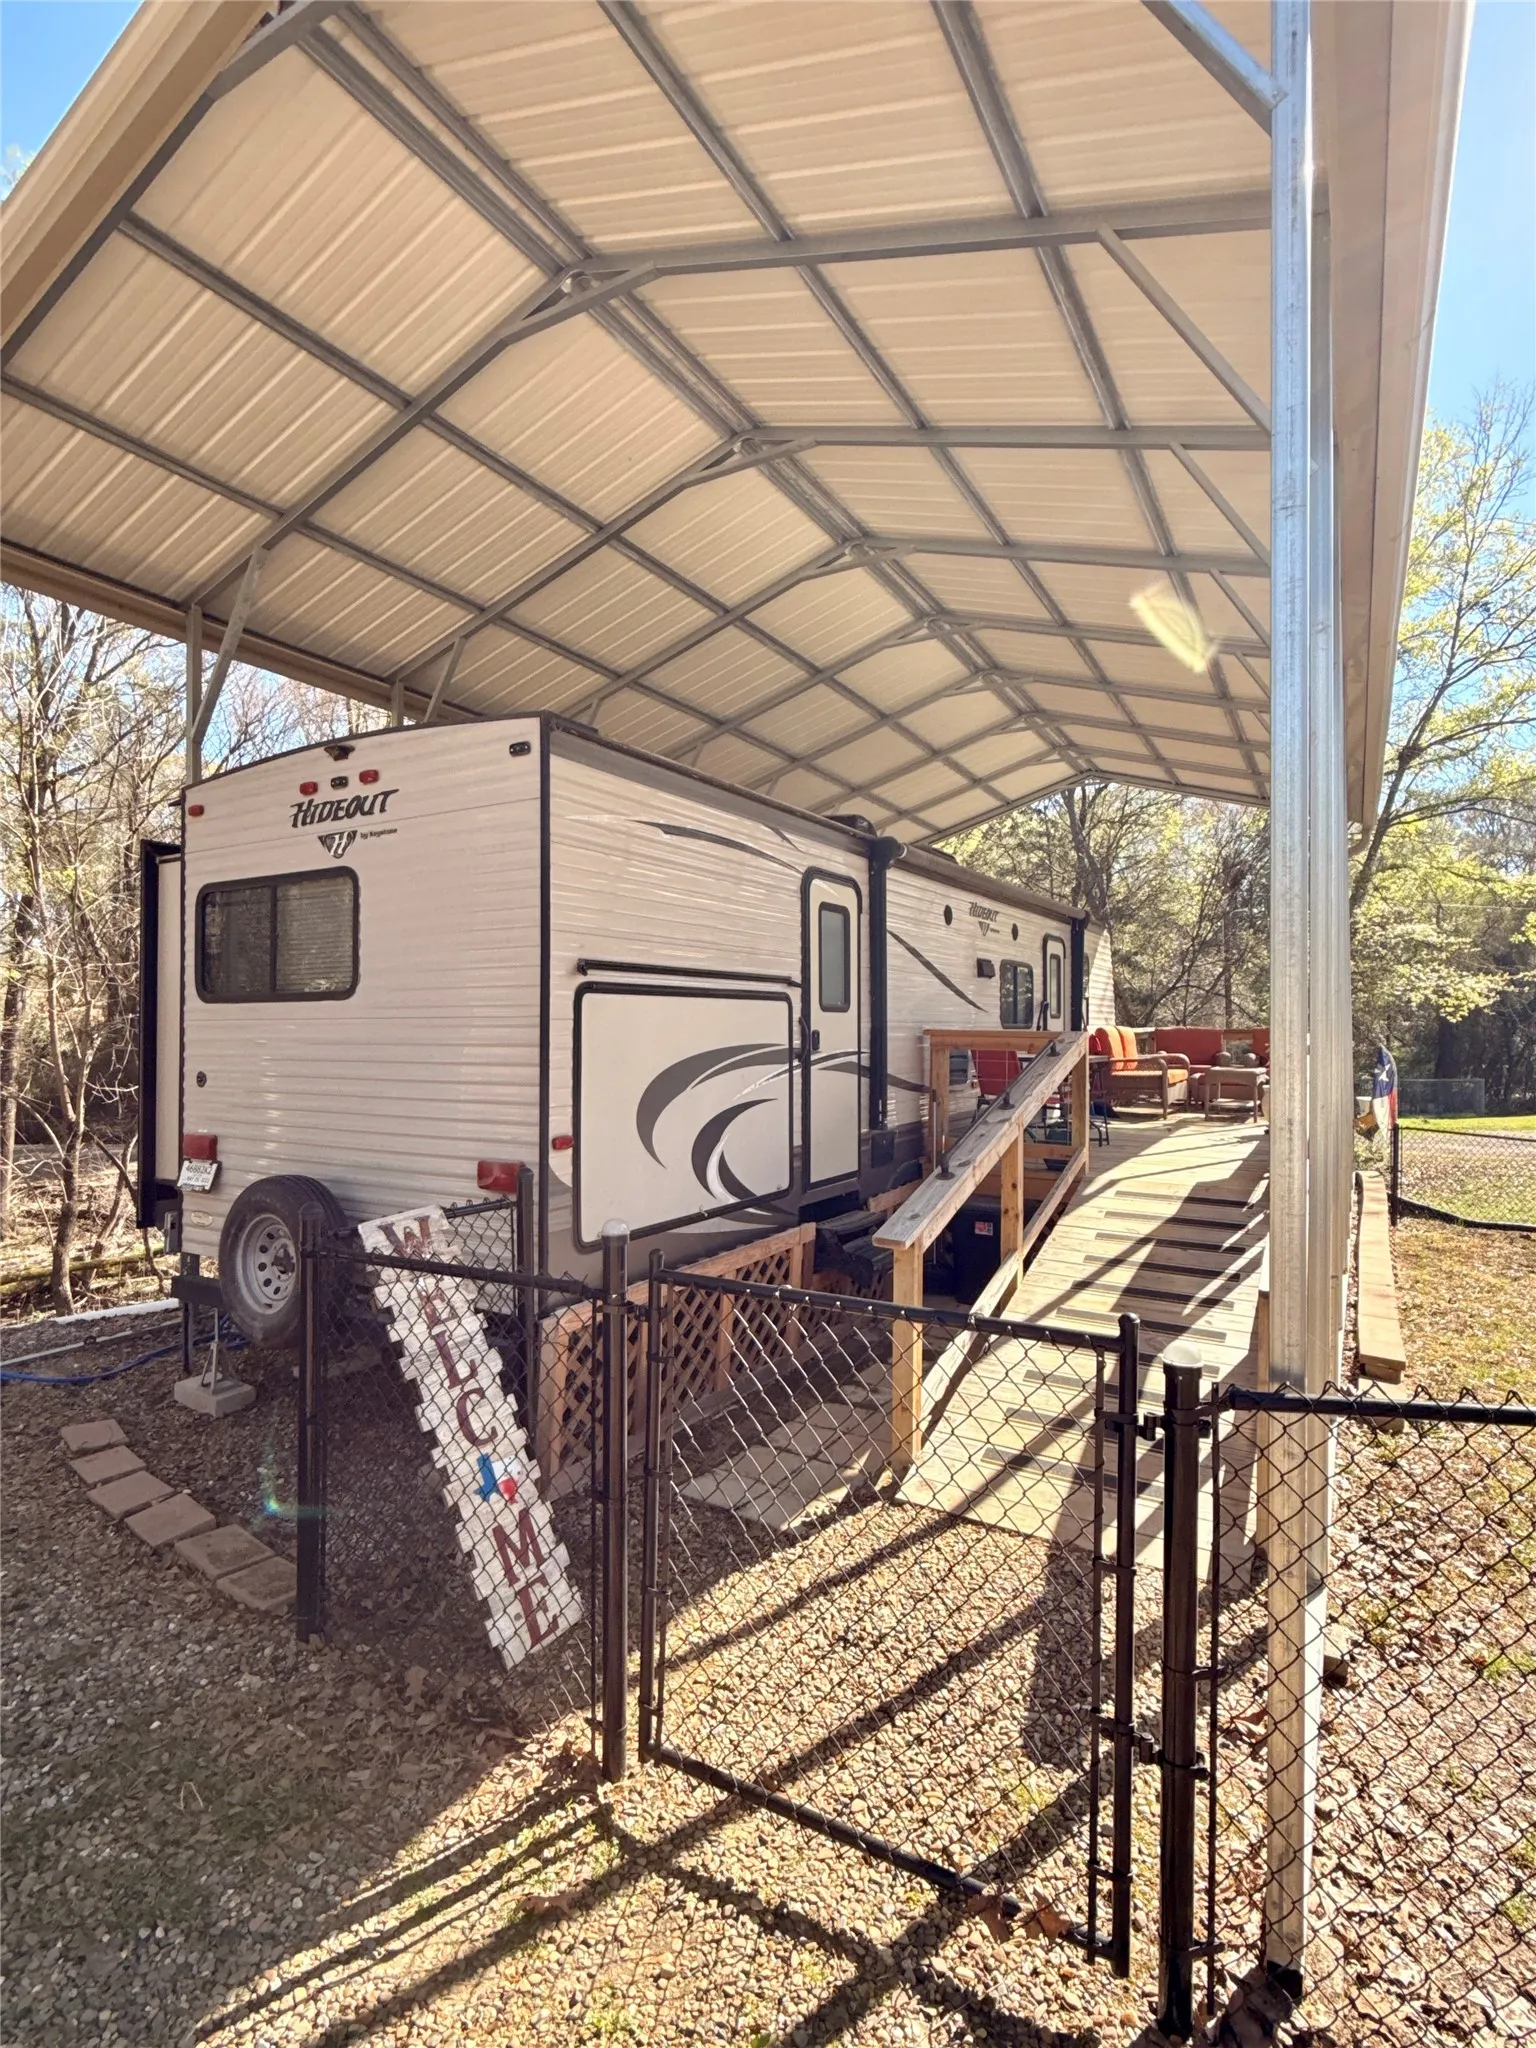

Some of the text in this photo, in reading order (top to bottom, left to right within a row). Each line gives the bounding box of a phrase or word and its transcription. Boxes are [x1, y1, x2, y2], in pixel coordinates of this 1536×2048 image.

[290, 788, 399, 828] HIDEOUT
[360, 832, 368, 840] by
[968, 901, 1000, 923] HIDEOUT
